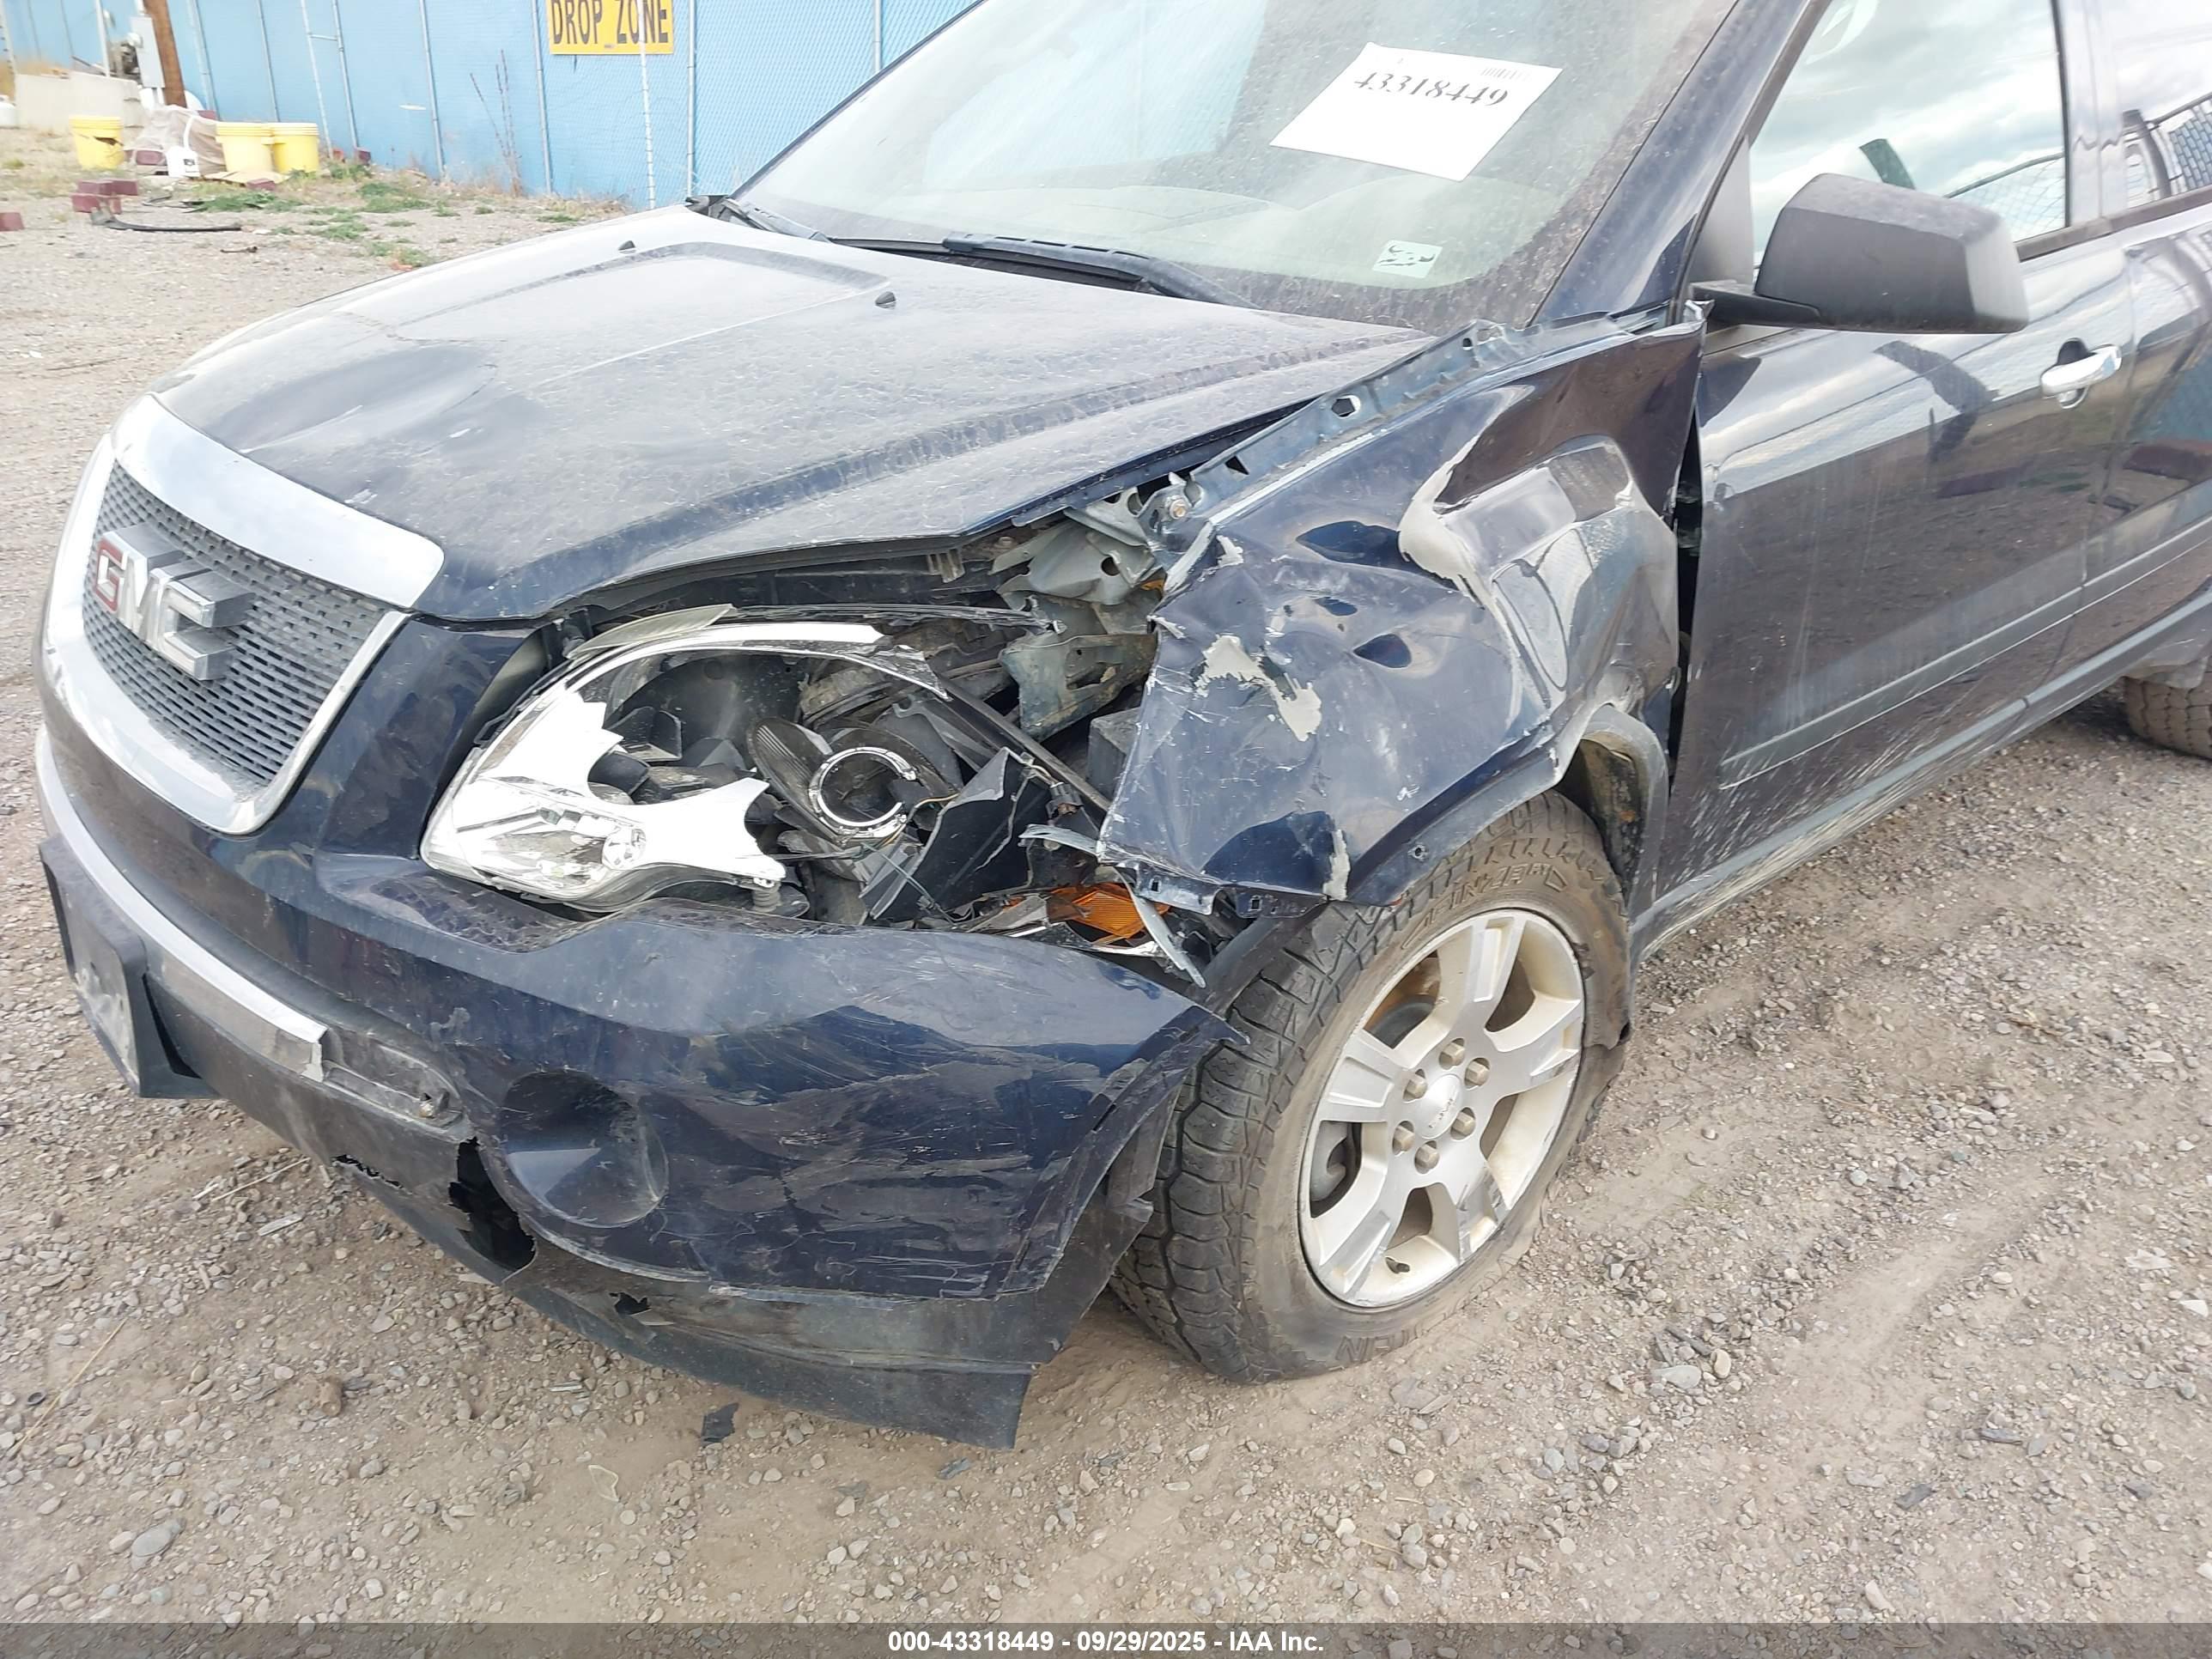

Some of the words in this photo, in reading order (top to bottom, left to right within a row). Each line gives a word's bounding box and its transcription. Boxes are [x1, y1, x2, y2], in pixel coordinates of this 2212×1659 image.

[550, 0, 603, 45] DROP
[615, 0, 669, 45] ZONE
[1353, 71, 1509, 107] 43318449
[93, 529, 225, 681] GMC
